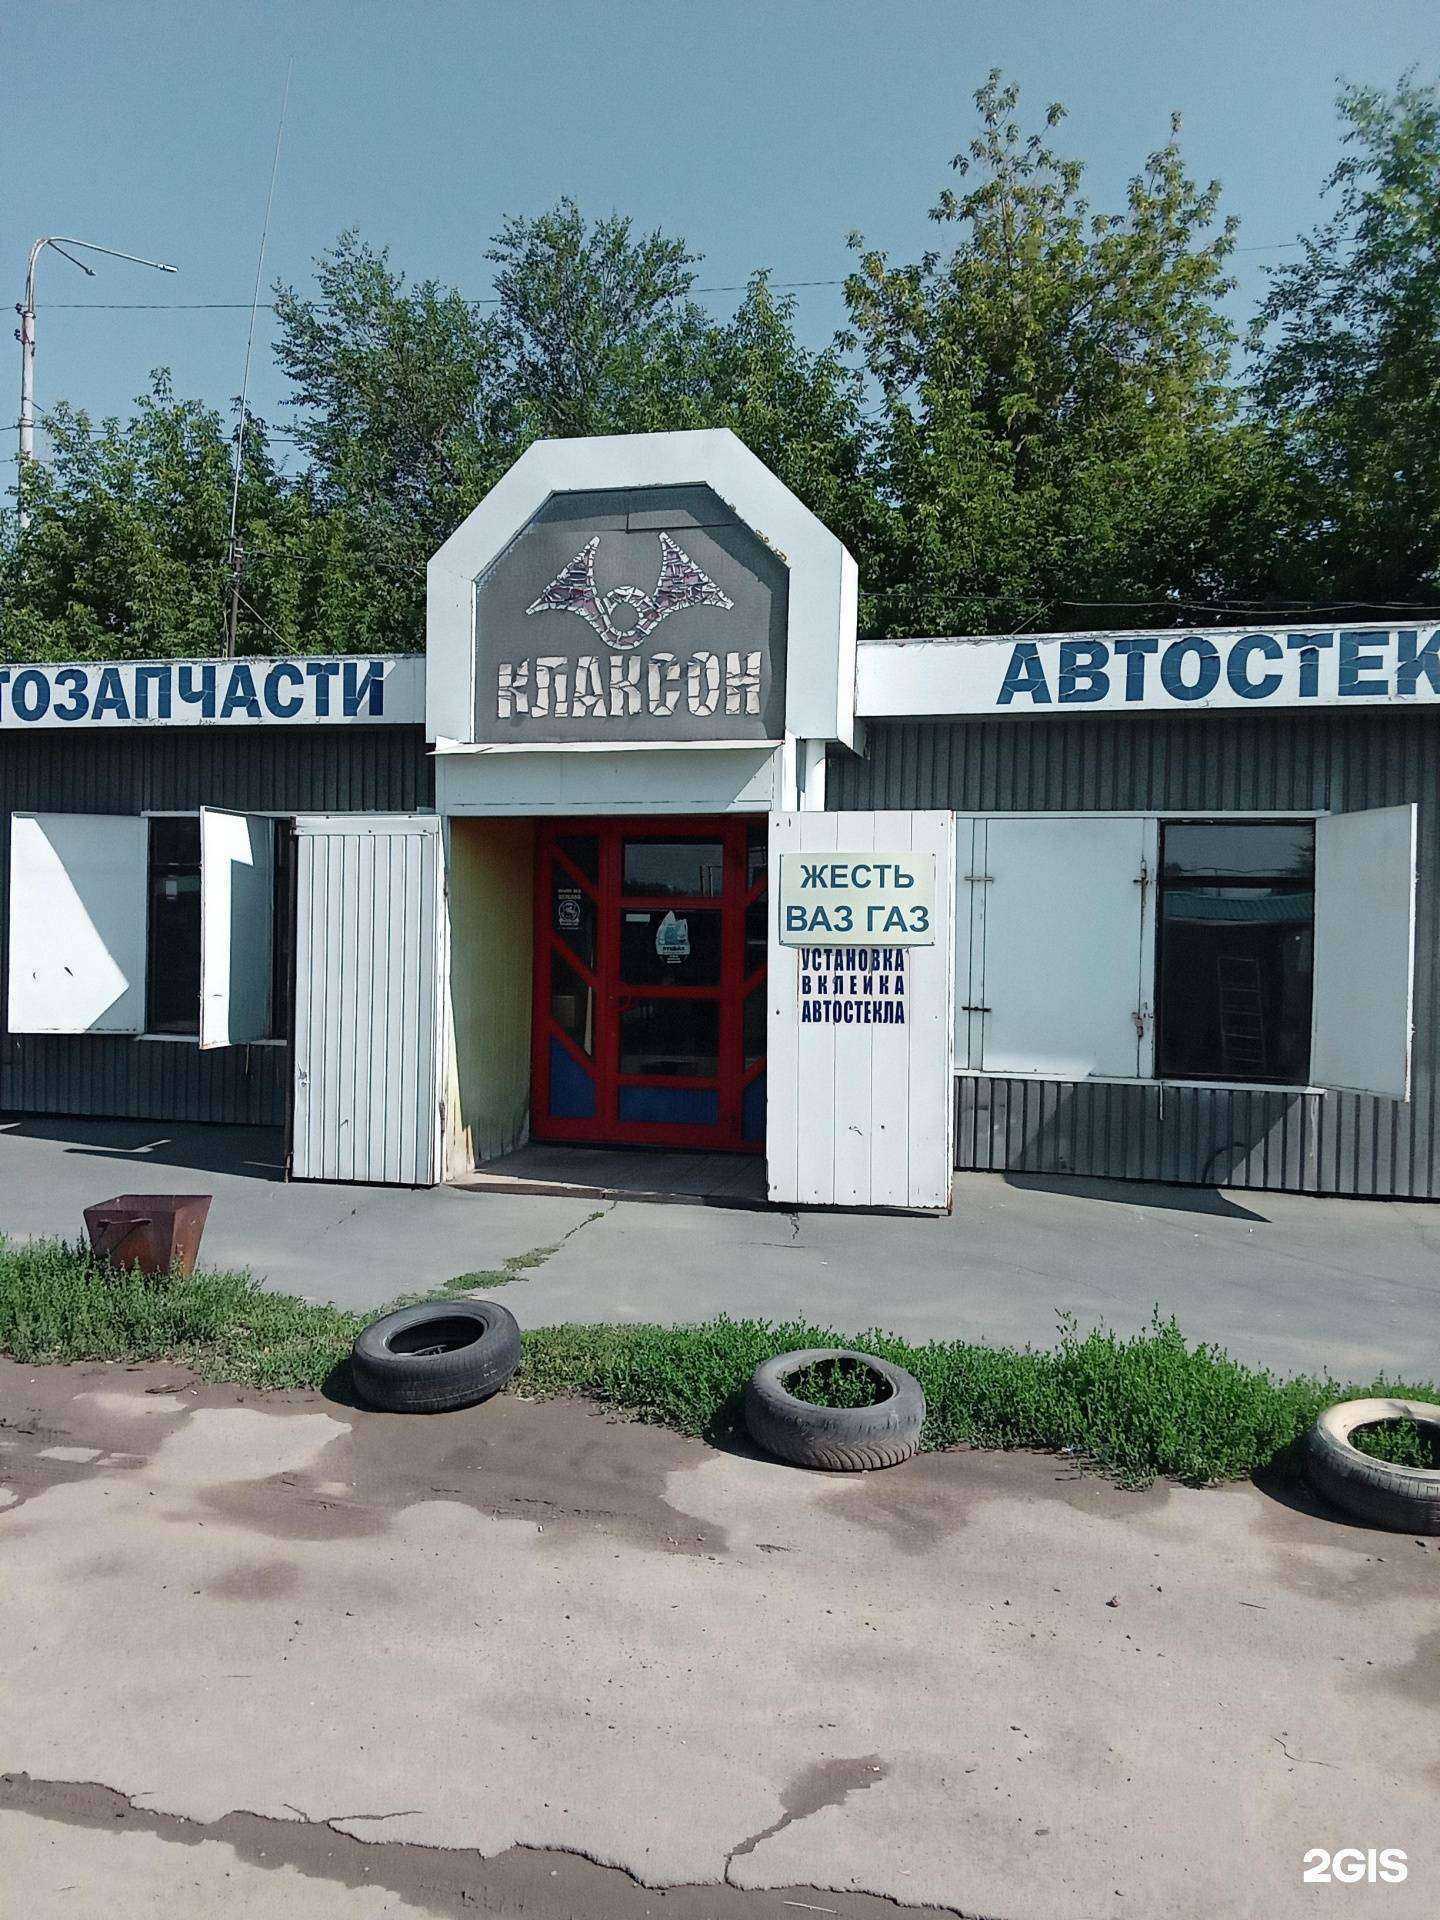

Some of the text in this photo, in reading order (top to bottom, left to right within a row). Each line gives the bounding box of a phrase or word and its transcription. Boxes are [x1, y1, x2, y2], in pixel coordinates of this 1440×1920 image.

[995, 630, 1440, 704] АВТОСТЕК
[497, 651, 762, 719] КЛАКСОН
[800, 864, 915, 889] ЖЕСТЬ
[786, 905, 930, 932] ВАЗ ГАЗ
[801, 948, 905, 971] УСТАНОВКА
[801, 1000, 905, 1024] АВТОСТЕКЛА
